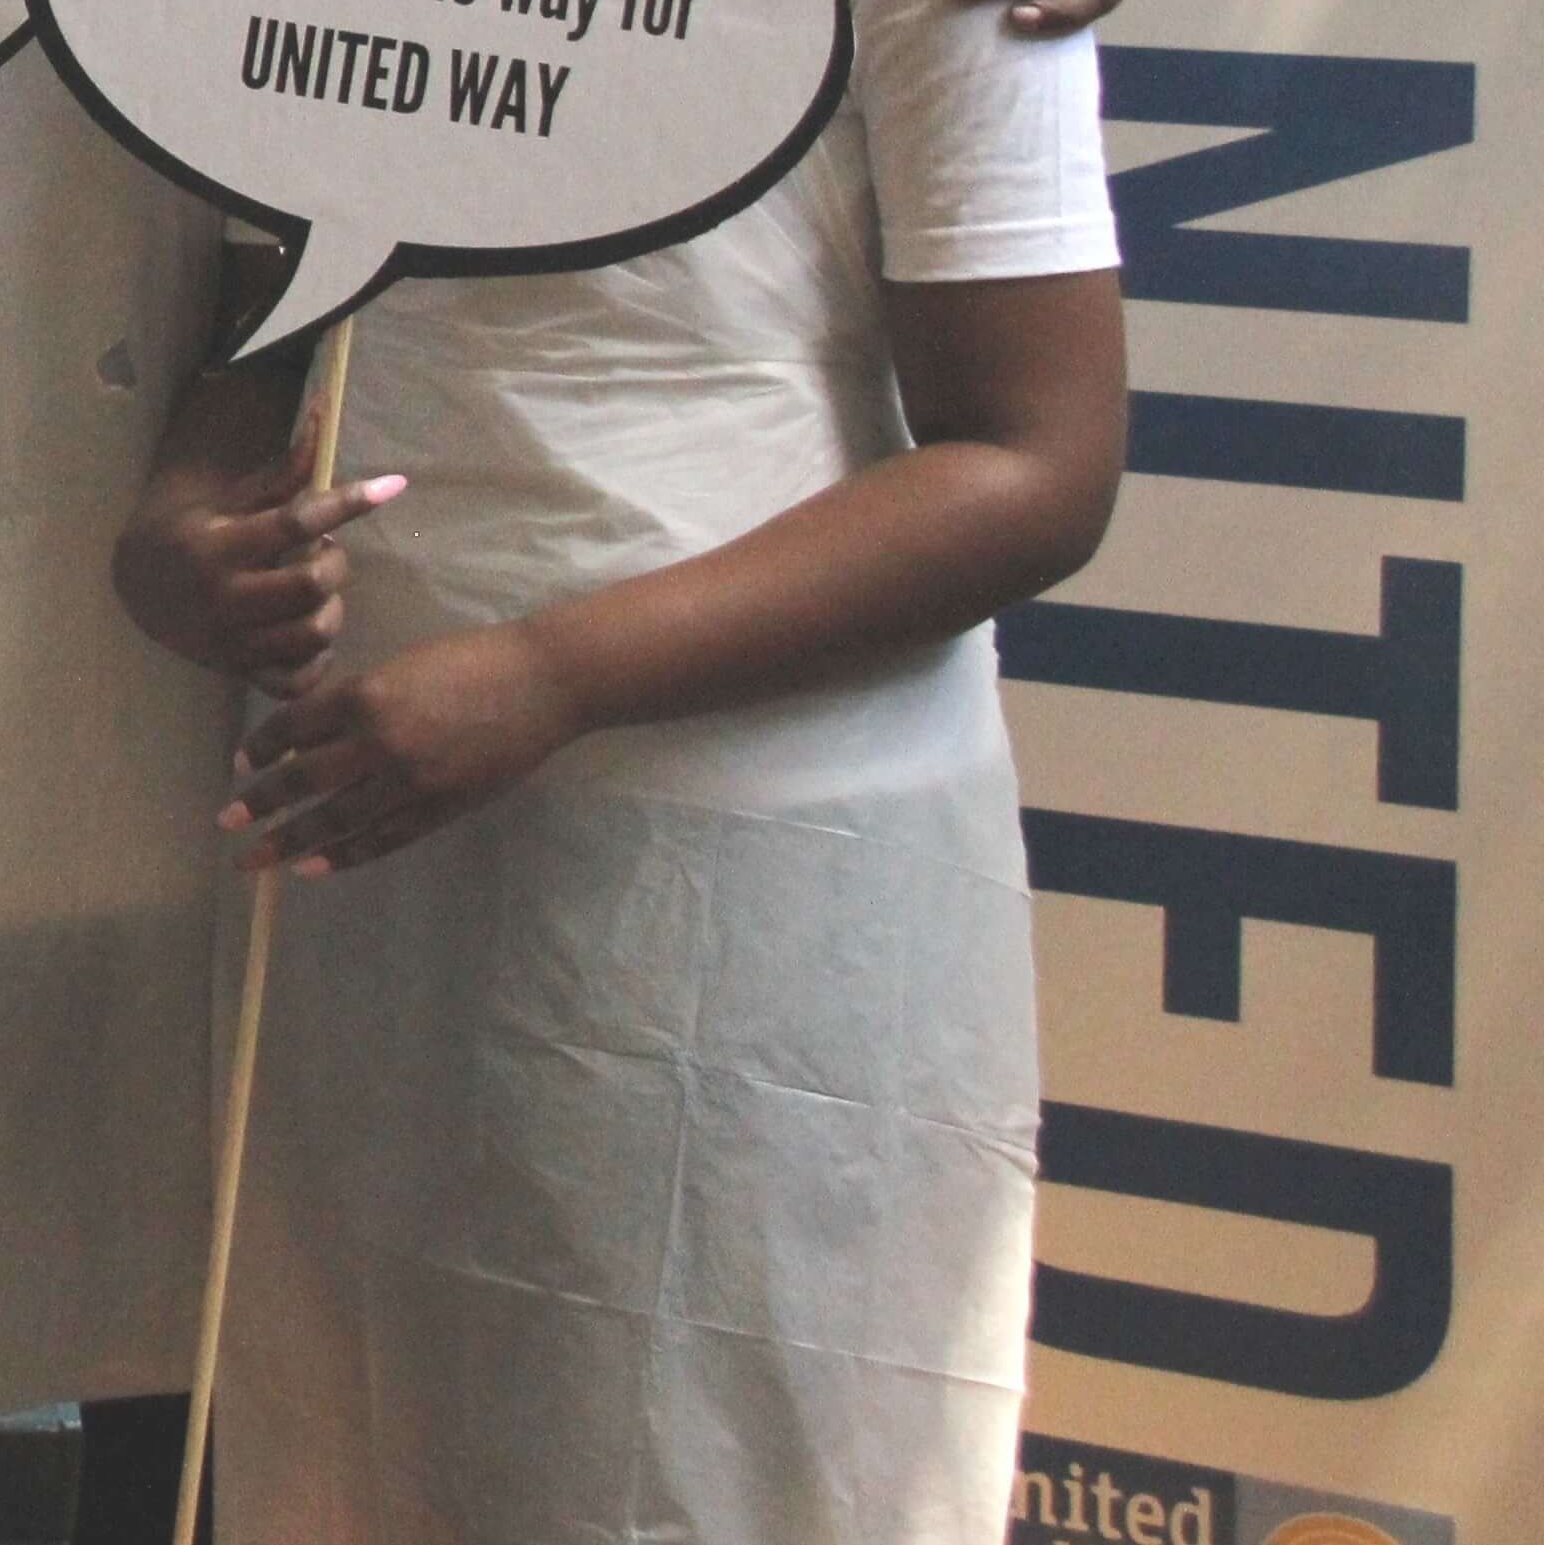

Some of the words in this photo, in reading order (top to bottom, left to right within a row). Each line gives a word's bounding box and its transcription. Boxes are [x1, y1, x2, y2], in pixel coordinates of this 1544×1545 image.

[241, 16, 428, 115] UNITED
[449, 49, 571, 138] WAY
[1012, 1462, 1214, 1545] nited
